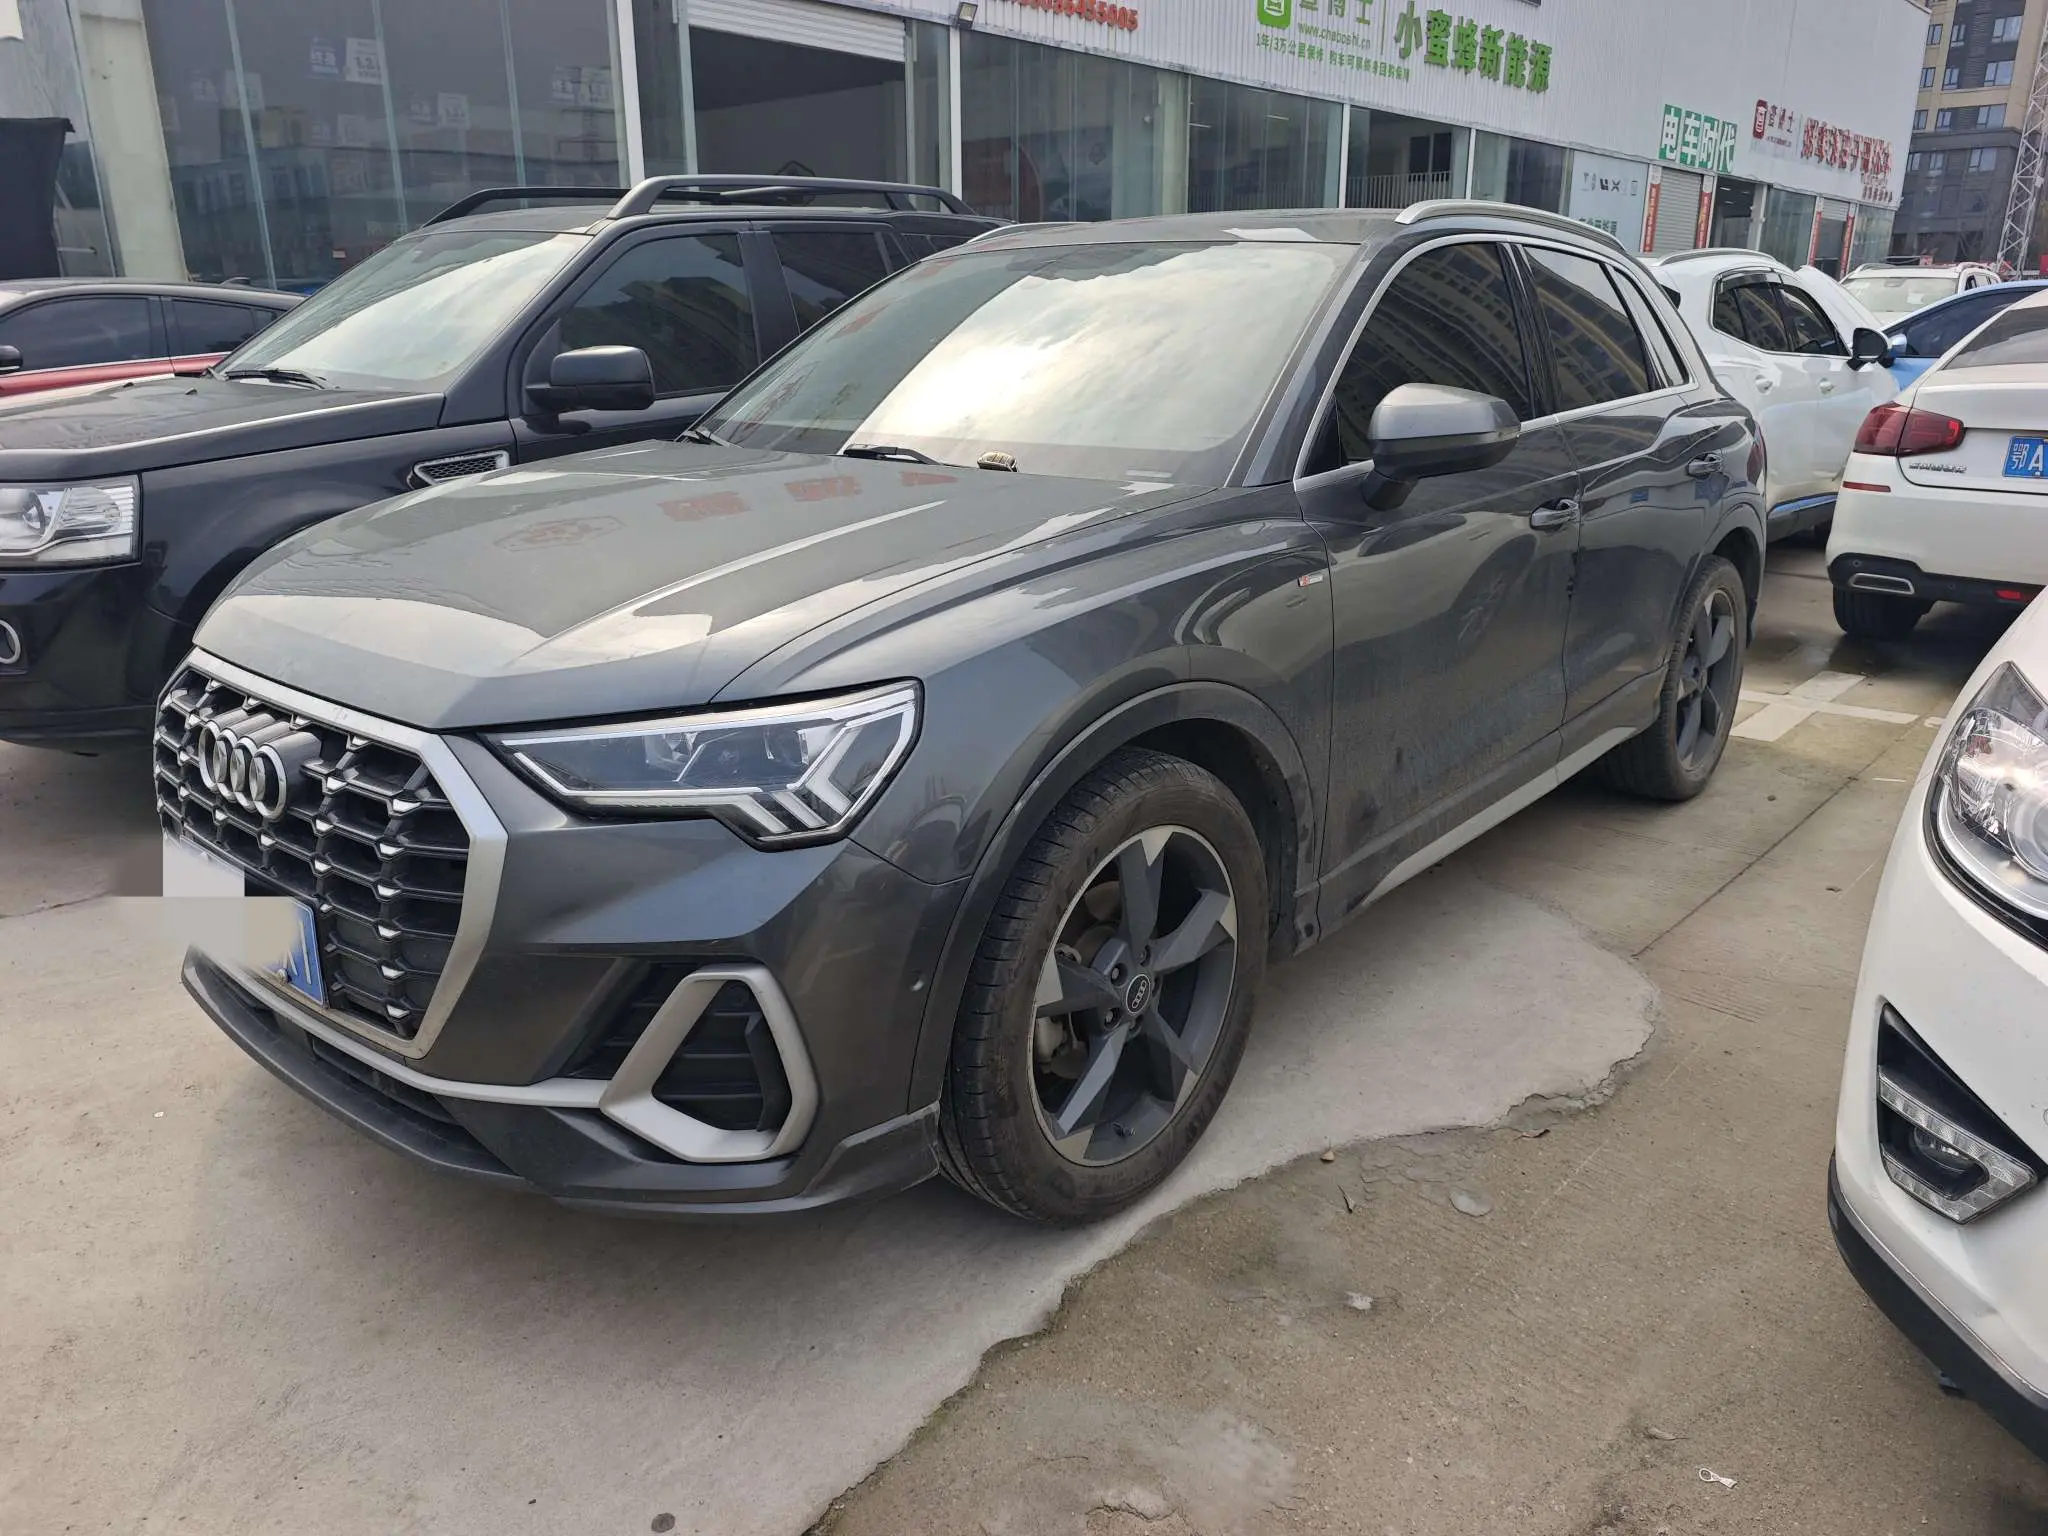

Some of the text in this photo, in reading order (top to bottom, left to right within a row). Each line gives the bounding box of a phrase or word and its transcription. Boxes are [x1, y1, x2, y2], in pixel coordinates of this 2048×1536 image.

[1394, 0, 1553, 94] 小蜜蜂新能源
[1659, 105, 1737, 173] 电车时代
